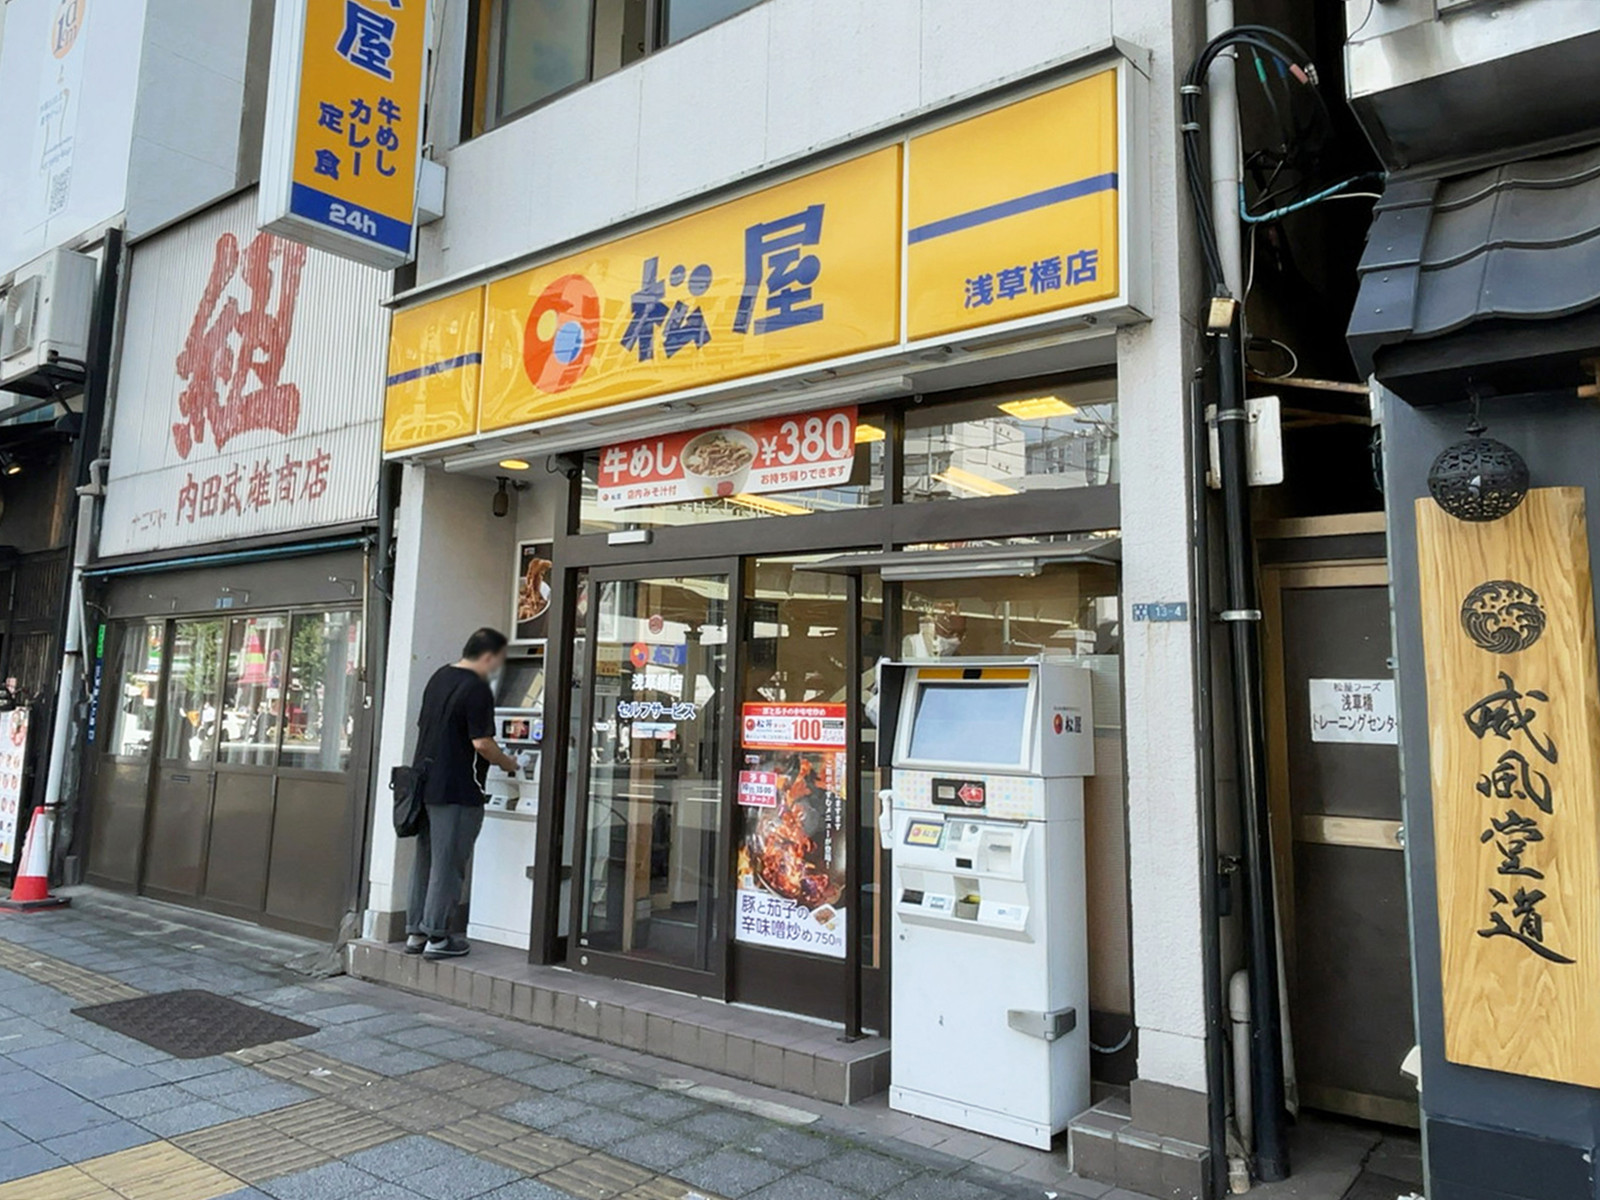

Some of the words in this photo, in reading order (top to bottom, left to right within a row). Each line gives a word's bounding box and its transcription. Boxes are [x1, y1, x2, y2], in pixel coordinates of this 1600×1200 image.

[336, 0, 402, 80] 屋
[313, 101, 344, 180] 定食
[348, 99, 371, 177] カレー
[376, 97, 401, 177] 牛めし
[329, 203, 377, 236] 24h
[620, 204, 825, 362] 松屋
[964, 249, 1098, 309] 浅草橋店
[603, 442, 678, 483] 牛めし
[761, 464, 846, 484] お持ち帰りできます
[176, 448, 331, 526] 内田武雄商店
[1156, 605, 1182, 617] 13-4
[1333, 681, 1382, 692] 松屋フーズ
[617, 701, 697, 720] セルフサービス
[1341, 693, 1374, 712] 浅草橋
[791, 719, 822, 741] 100
[1312, 713, 1398, 733] トレーニングセンタ
[741, 894, 810, 920] 豚と茄子の
[741, 916, 813, 942] 辛味噌炒め
